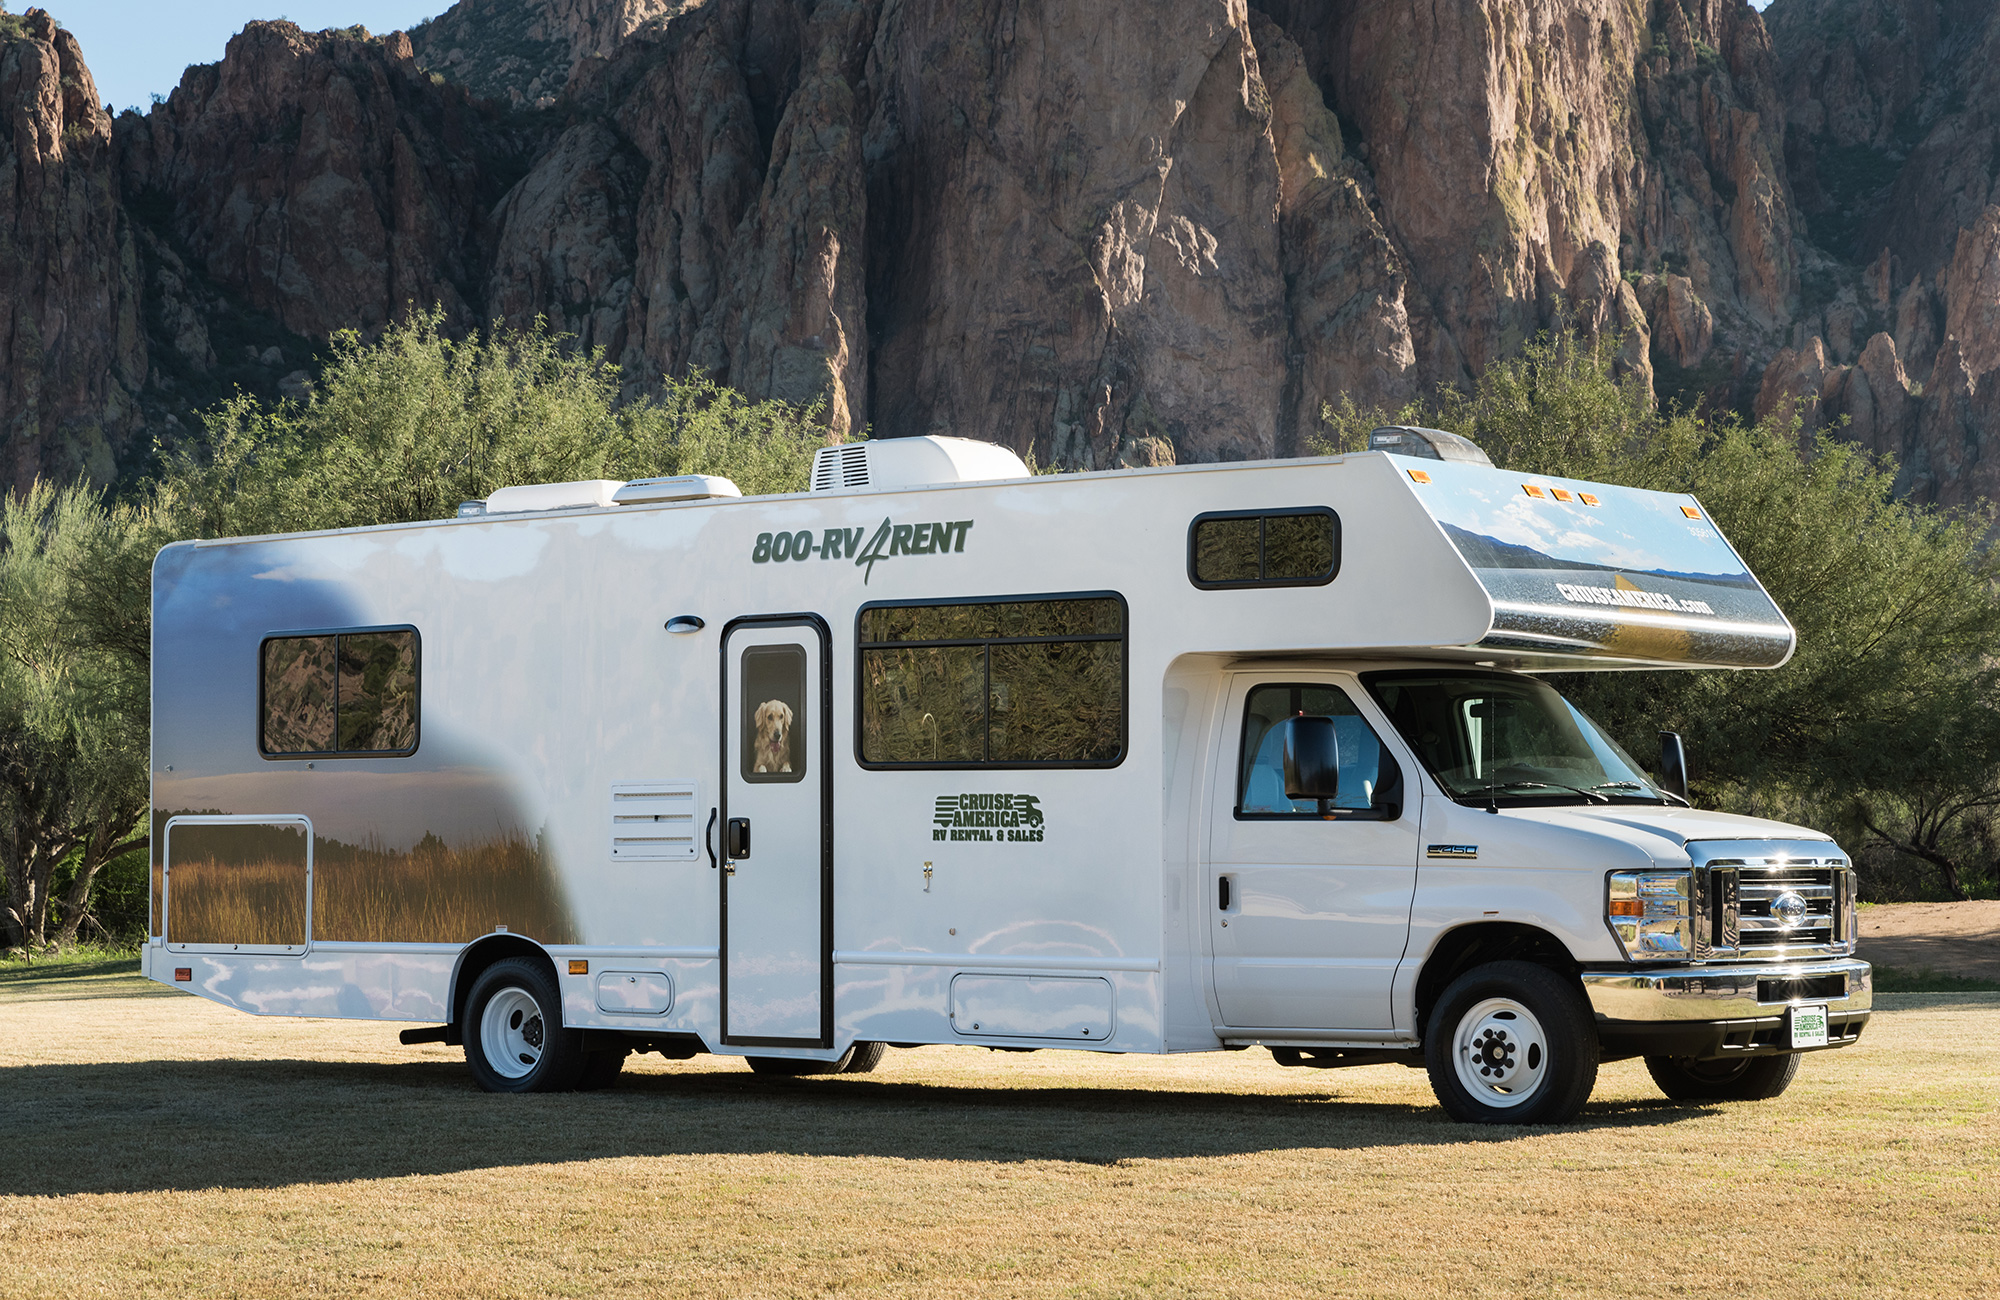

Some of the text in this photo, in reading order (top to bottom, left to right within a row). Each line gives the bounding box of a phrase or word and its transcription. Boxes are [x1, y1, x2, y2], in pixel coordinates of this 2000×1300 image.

[1555, 583, 1715, 615] CRUISEAMERICA.com
[959, 793, 1013, 810] CRUISE
[952, 811, 1020, 827] AMERICA
[932, 829, 1044, 841] RV RENTAL & SALES
